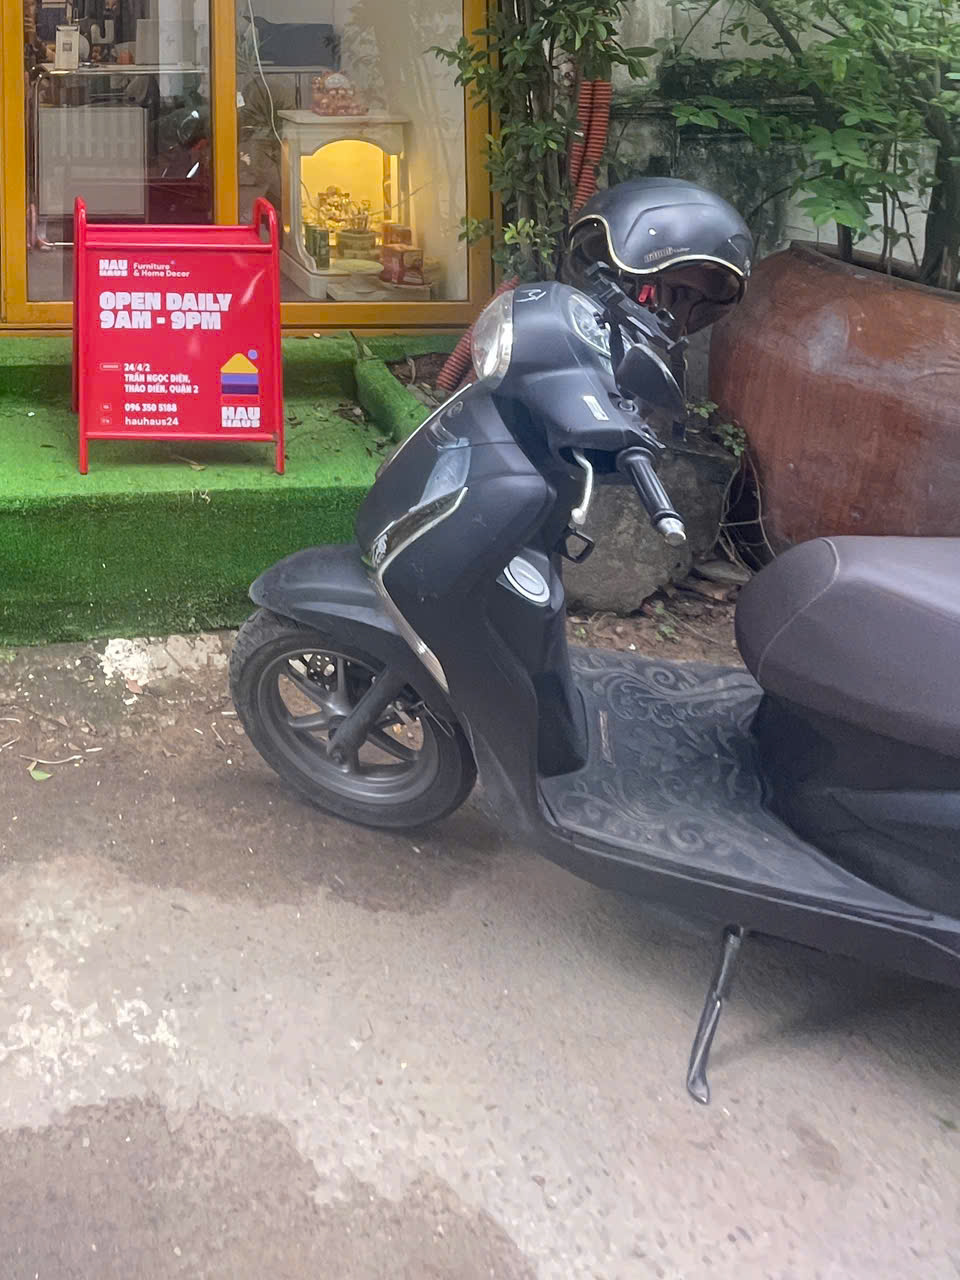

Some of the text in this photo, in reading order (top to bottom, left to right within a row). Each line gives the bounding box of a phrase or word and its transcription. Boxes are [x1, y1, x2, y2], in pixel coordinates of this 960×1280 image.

[99, 259, 128, 270] HAU
[133, 262, 170, 270] Furniture
[99, 291, 233, 311] OPEN DAILY
[99, 310, 221, 330] 9AM - 9PM
[124, 363, 150, 372] 24/4/2
[193, 385, 199, 394] 2
[124, 403, 140, 412] 096
[142, 403, 157, 412] 350
[221, 406, 261, 420] HAU
[125, 416, 179, 425] hauhaus24
